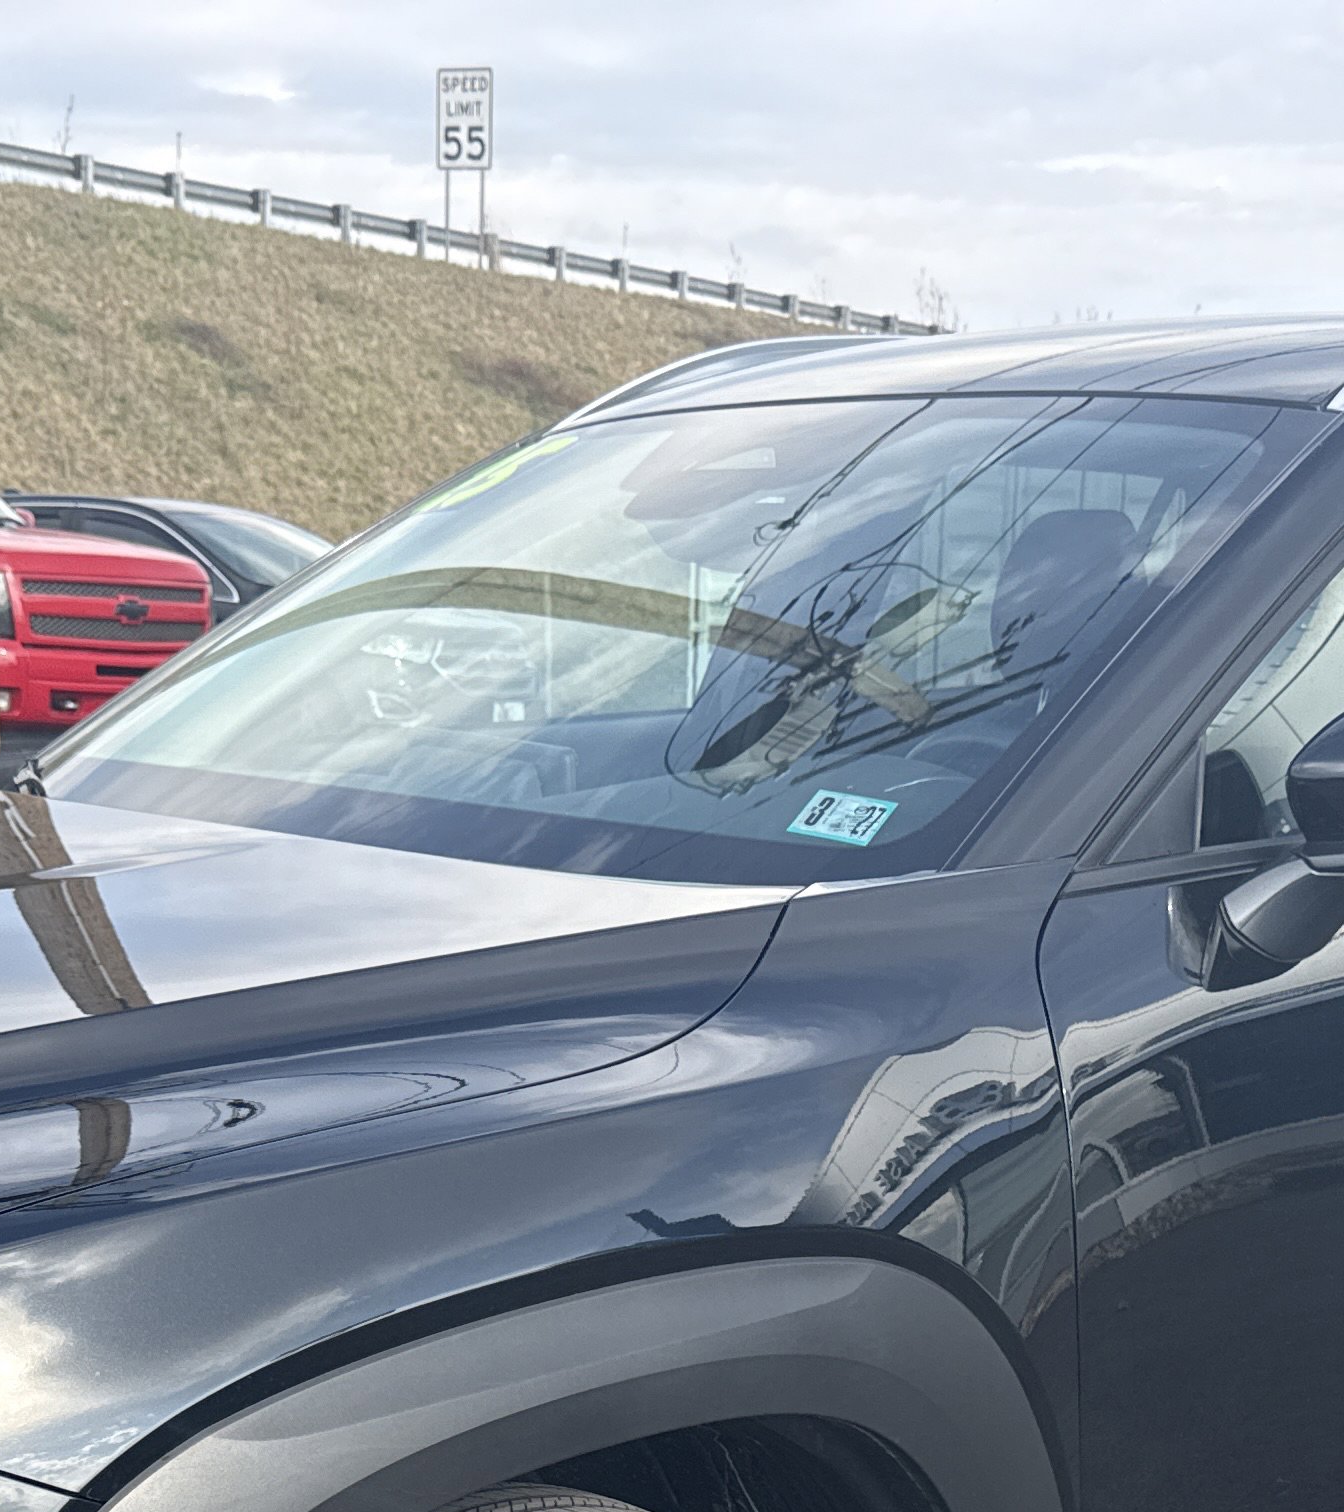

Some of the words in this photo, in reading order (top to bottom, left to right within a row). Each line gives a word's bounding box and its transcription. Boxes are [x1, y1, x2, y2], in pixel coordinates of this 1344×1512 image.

[441, 76, 489, 93] SPEED
[446, 101, 482, 117] LIMIT
[443, 125, 486, 161] 55
